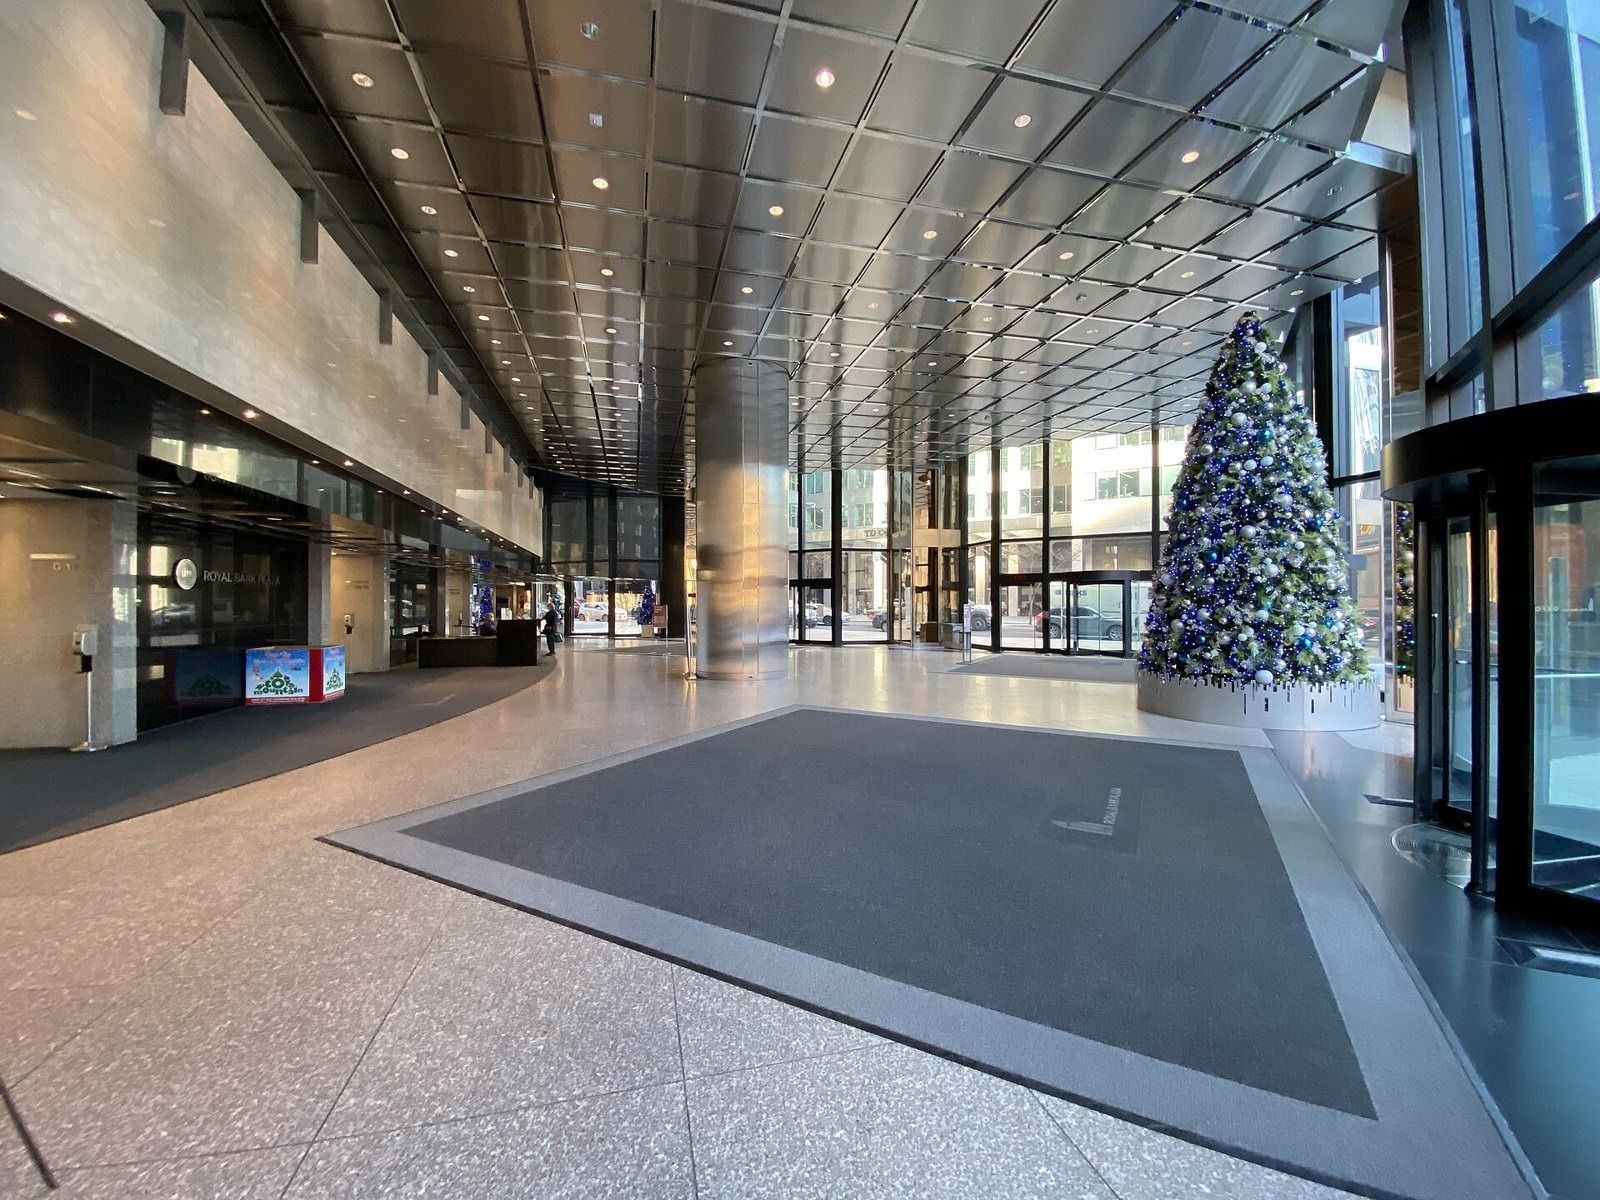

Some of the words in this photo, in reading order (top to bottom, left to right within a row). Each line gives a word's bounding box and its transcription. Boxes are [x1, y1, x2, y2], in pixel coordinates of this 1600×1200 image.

[864, 529, 876, 537] TD
[203, 570, 233, 583] ROYAL
[234, 573, 256, 584] BANK
